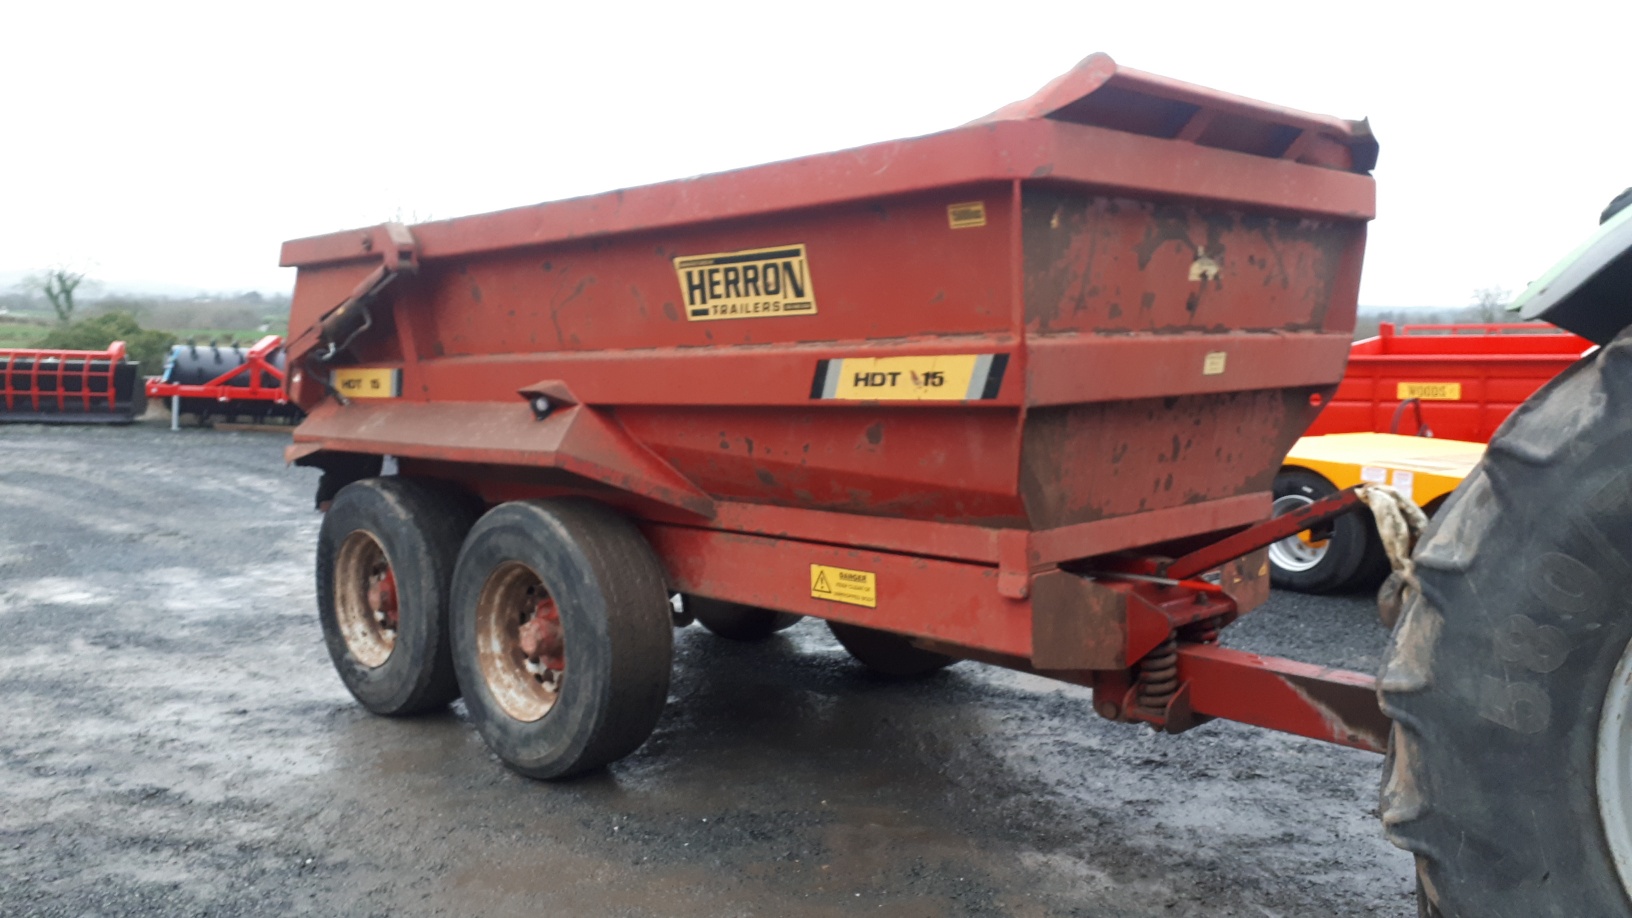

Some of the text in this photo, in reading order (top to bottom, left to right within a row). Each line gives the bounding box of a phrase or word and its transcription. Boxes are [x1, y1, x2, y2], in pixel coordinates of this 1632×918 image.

[686, 261, 805, 305] HERRON
[711, 301, 781, 315] TRAILERS
[853, 371, 944, 387] HDT 15
[839, 572, 867, 582] DANGER
